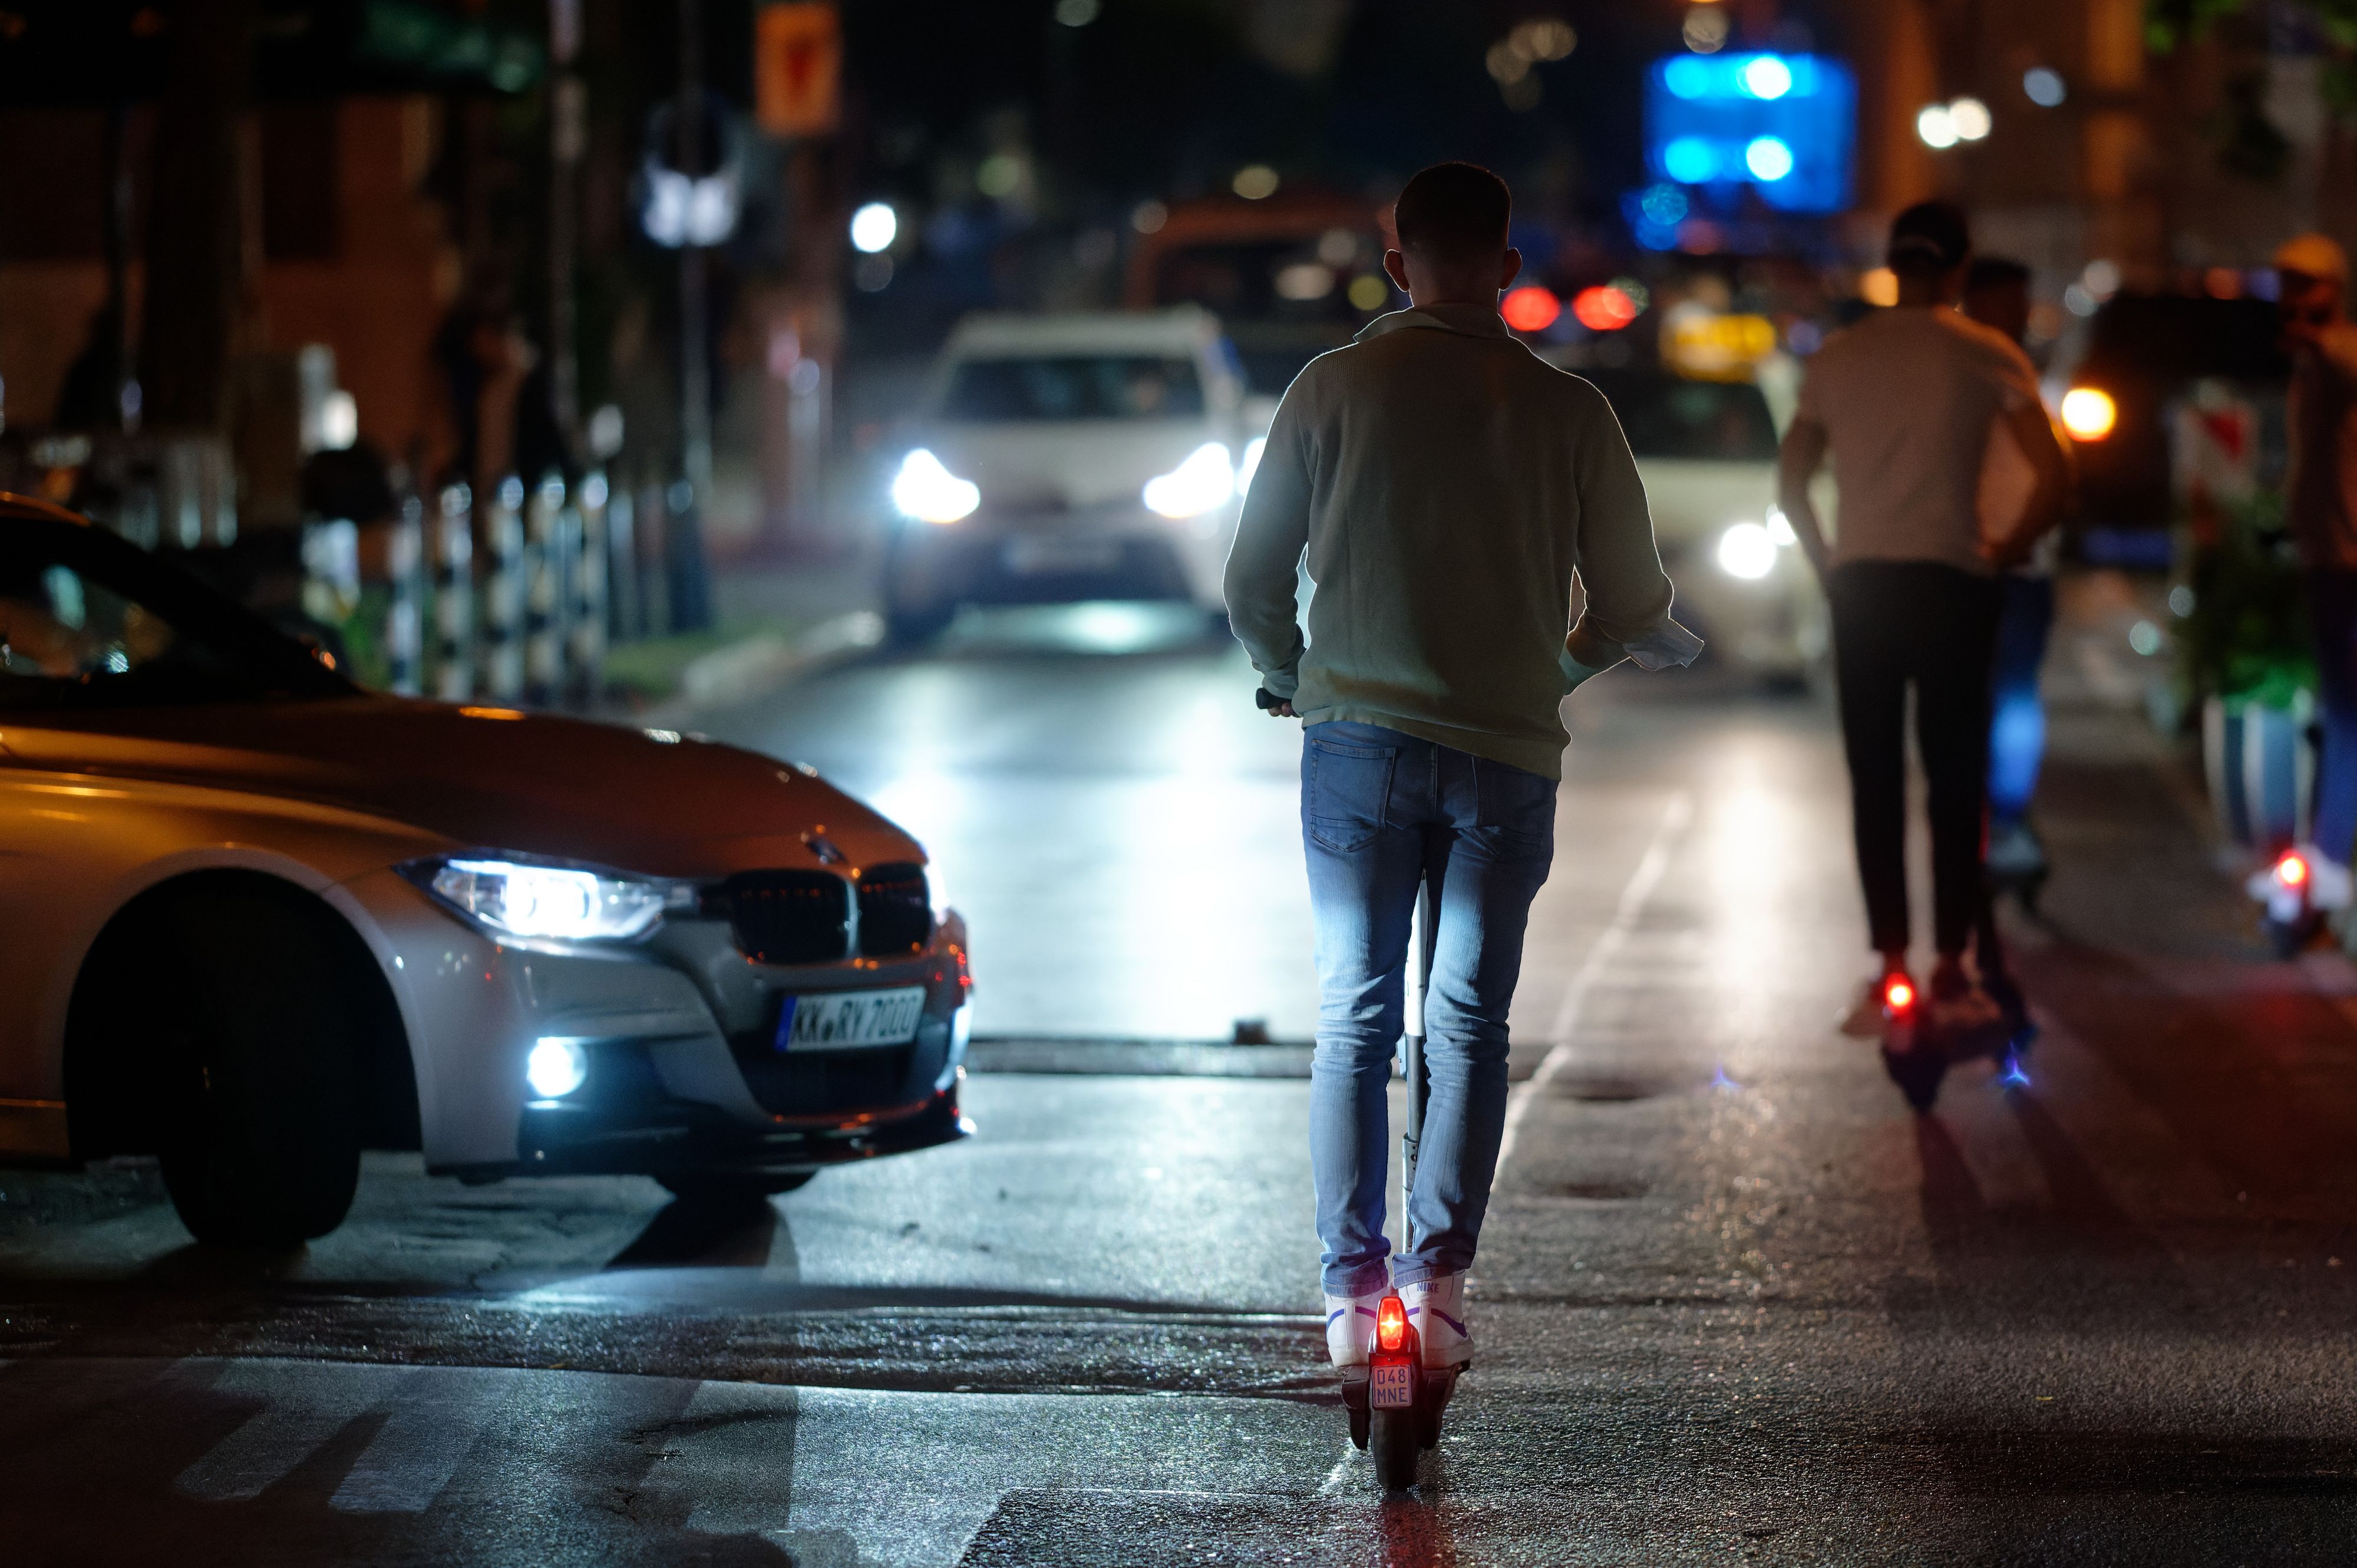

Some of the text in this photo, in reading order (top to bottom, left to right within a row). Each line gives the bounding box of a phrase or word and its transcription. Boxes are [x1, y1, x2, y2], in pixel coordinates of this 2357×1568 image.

[867, 995, 920, 1038] 7000
[1417, 1282, 1439, 1293] NIKE
[1377, 1369, 1406, 1384] 048
[1377, 1387, 1408, 1404] MNE
